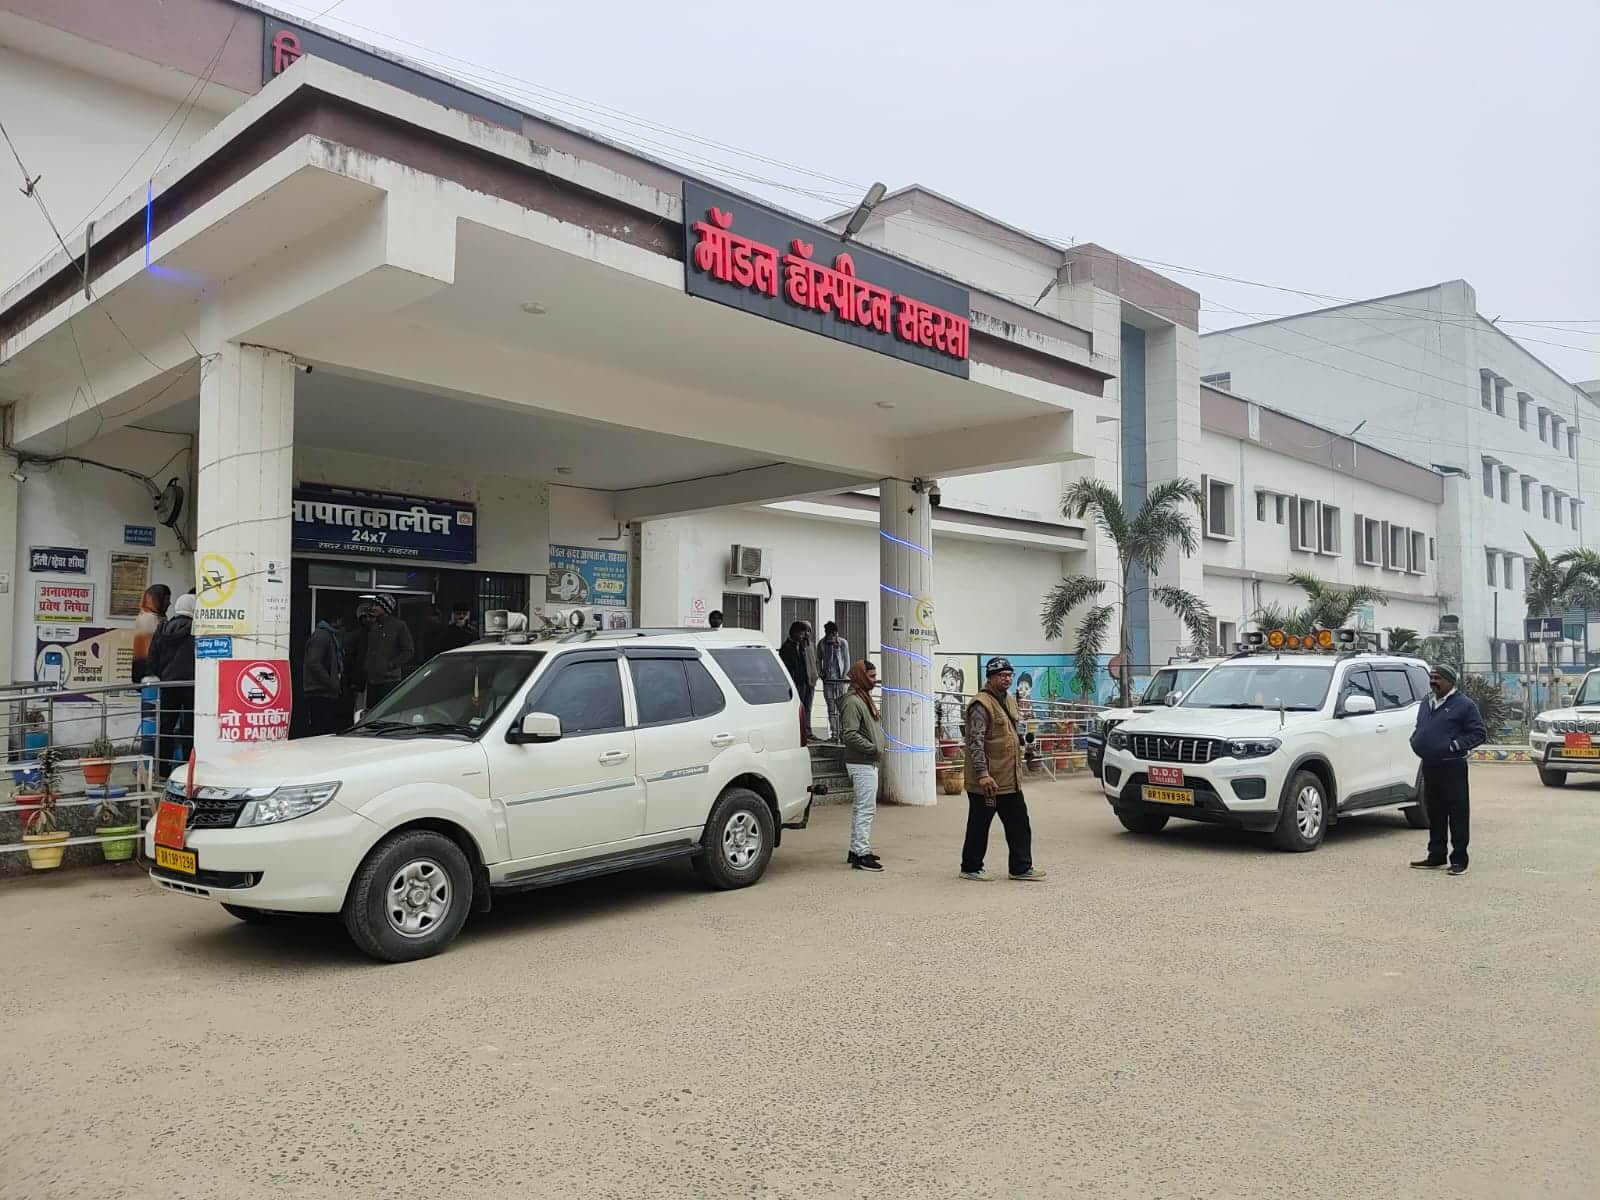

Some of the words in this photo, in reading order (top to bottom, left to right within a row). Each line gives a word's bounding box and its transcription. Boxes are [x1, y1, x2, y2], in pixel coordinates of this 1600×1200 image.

[692, 207, 779, 298] मॉडल
[783, 239, 892, 334] हॉस्पीटल
[894, 294, 969, 360] सहरसा
[351, 529, 388, 544] 24x7
[40, 586, 89, 599] अनावश्यक
[200, 608, 245, 620] PARKING
[220, 709, 242, 726] नो
[245, 708, 290, 727] पार्किंग
[221, 727, 241, 740] NO
[244, 726, 288, 740] PARKING
[1152, 767, 1179, 778] D.D.C
